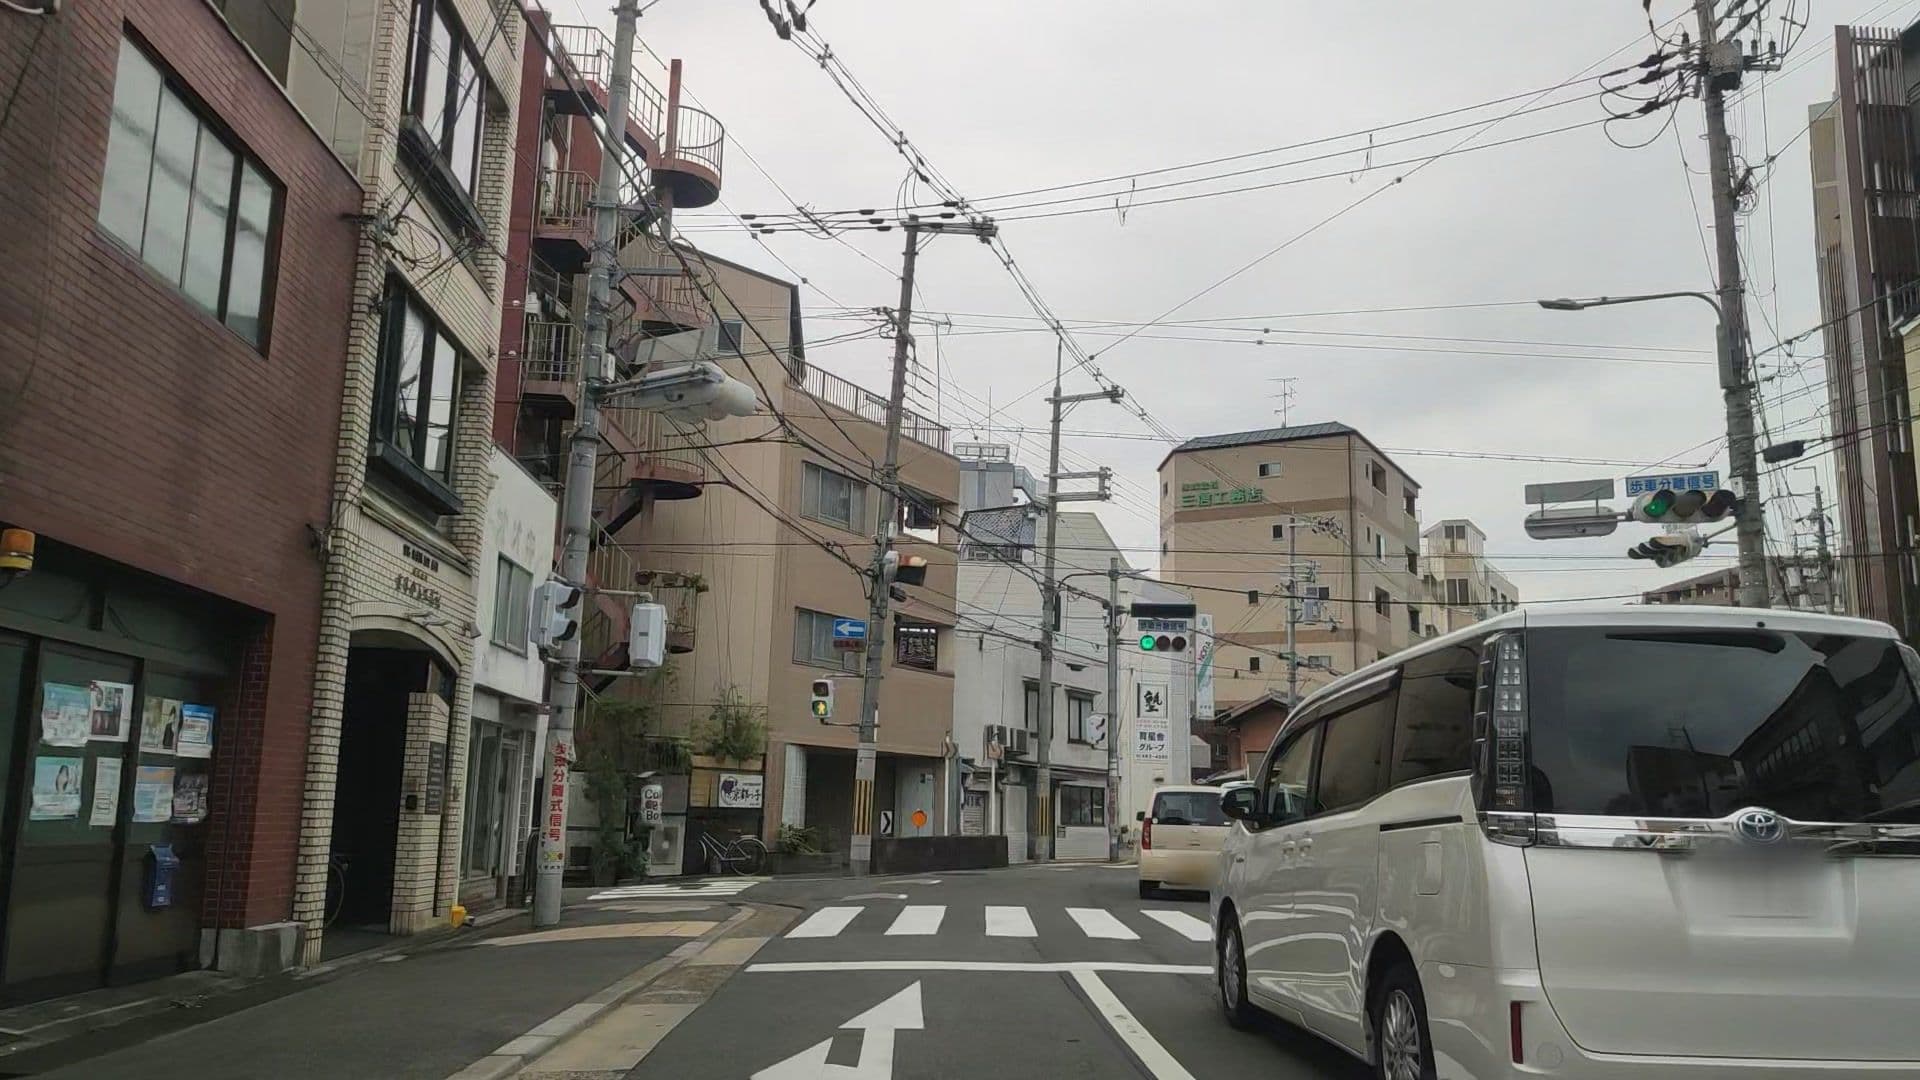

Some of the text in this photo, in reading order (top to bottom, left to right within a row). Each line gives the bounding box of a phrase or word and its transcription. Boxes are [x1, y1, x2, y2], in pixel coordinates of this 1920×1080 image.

[1143, 690, 1163, 713] 塾
[1138, 743, 1165, 753] グループ
